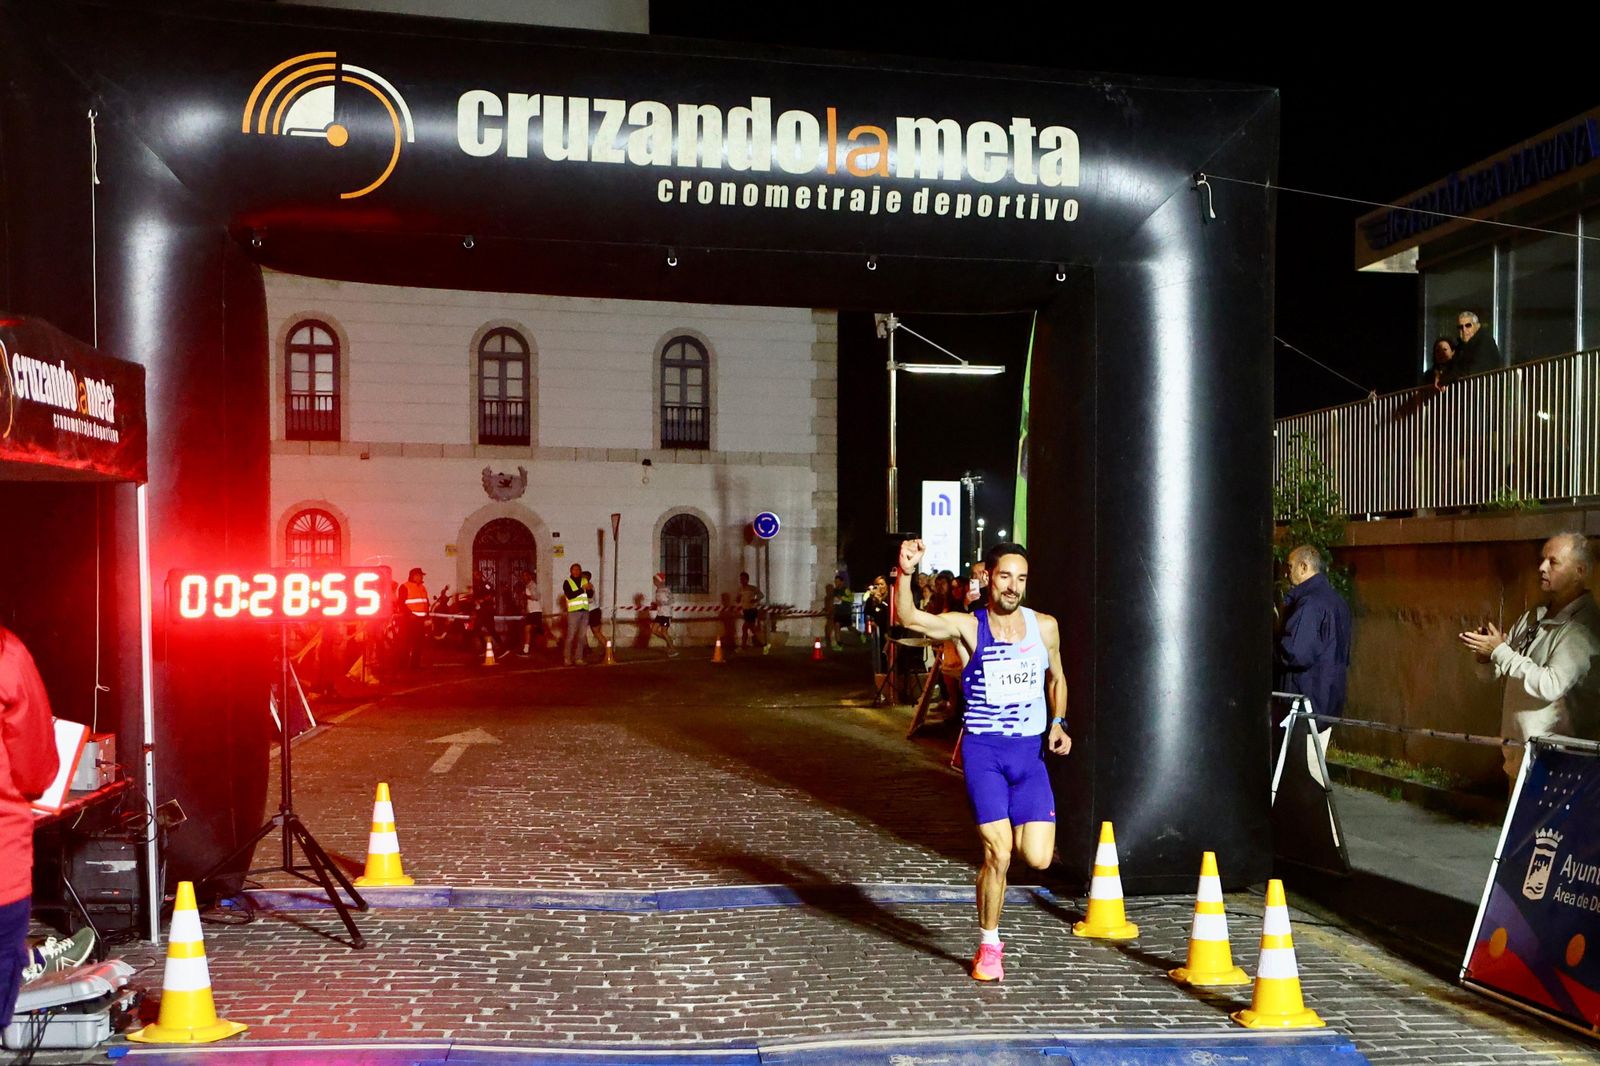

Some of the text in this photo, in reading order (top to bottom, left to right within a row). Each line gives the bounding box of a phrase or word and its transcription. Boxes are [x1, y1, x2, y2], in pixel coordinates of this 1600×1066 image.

[657, 177, 1081, 222] cronometraje deportivo
[179, 572, 381, 619] 00:28:55
[1000, 672, 1028, 686] 1162
[1553, 882, 1576, 906] Área
[1577, 892, 1589, 909] de
